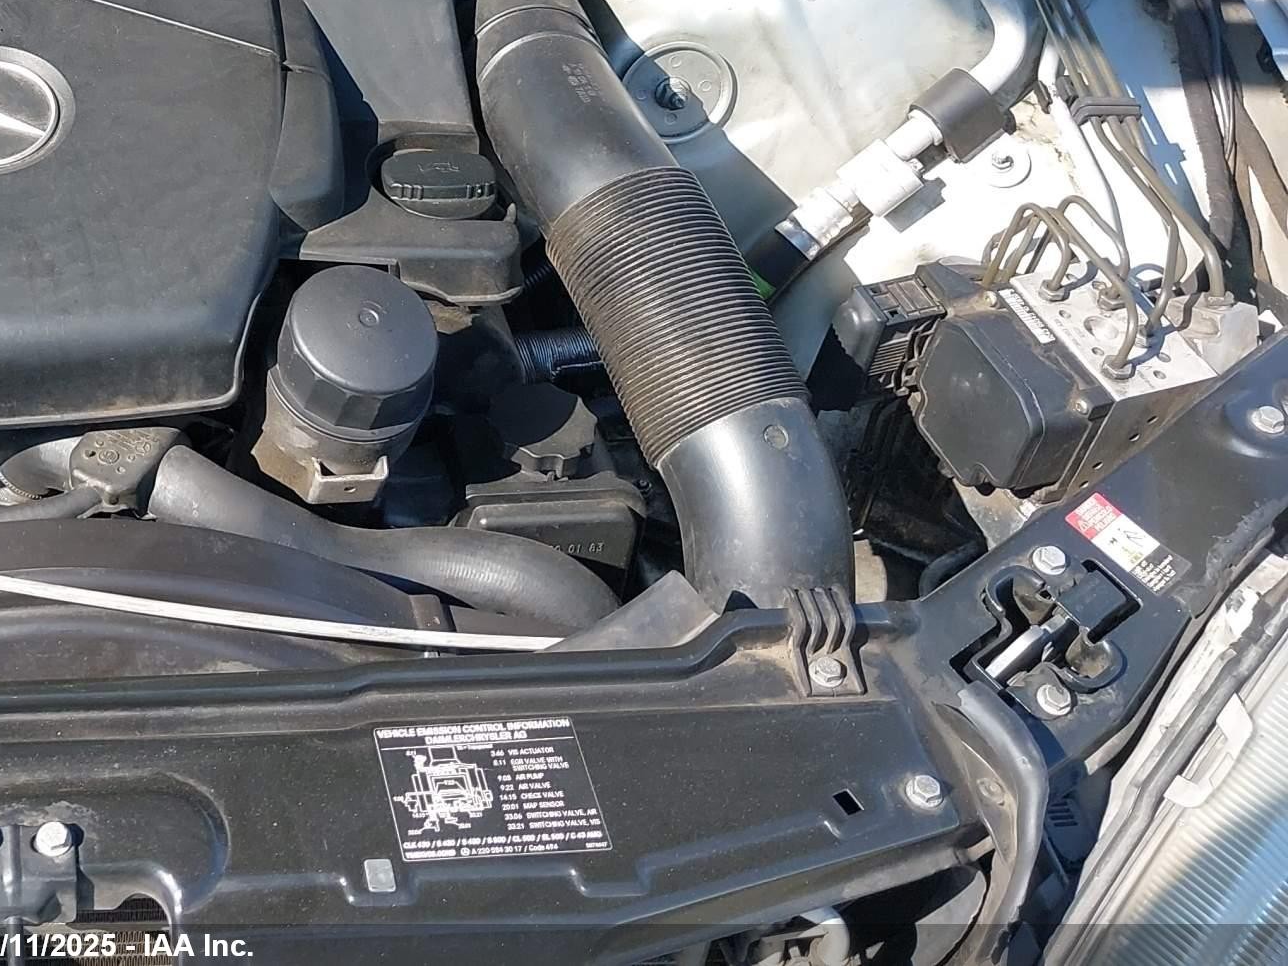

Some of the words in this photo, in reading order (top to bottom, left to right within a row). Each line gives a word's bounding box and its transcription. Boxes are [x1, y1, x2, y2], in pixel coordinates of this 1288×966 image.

[377, 729, 416, 739] VEHICLE
[417, 726, 461, 737] EMISSION
[462, 724, 505, 734] CONTROL
[507, 719, 571, 730] INFORMATION
[520, 747, 554, 755] ACTUATOR
[524, 757, 546, 765] VALVE
[529, 781, 551, 789] VALVE
[529, 844, 544, 852] Code
